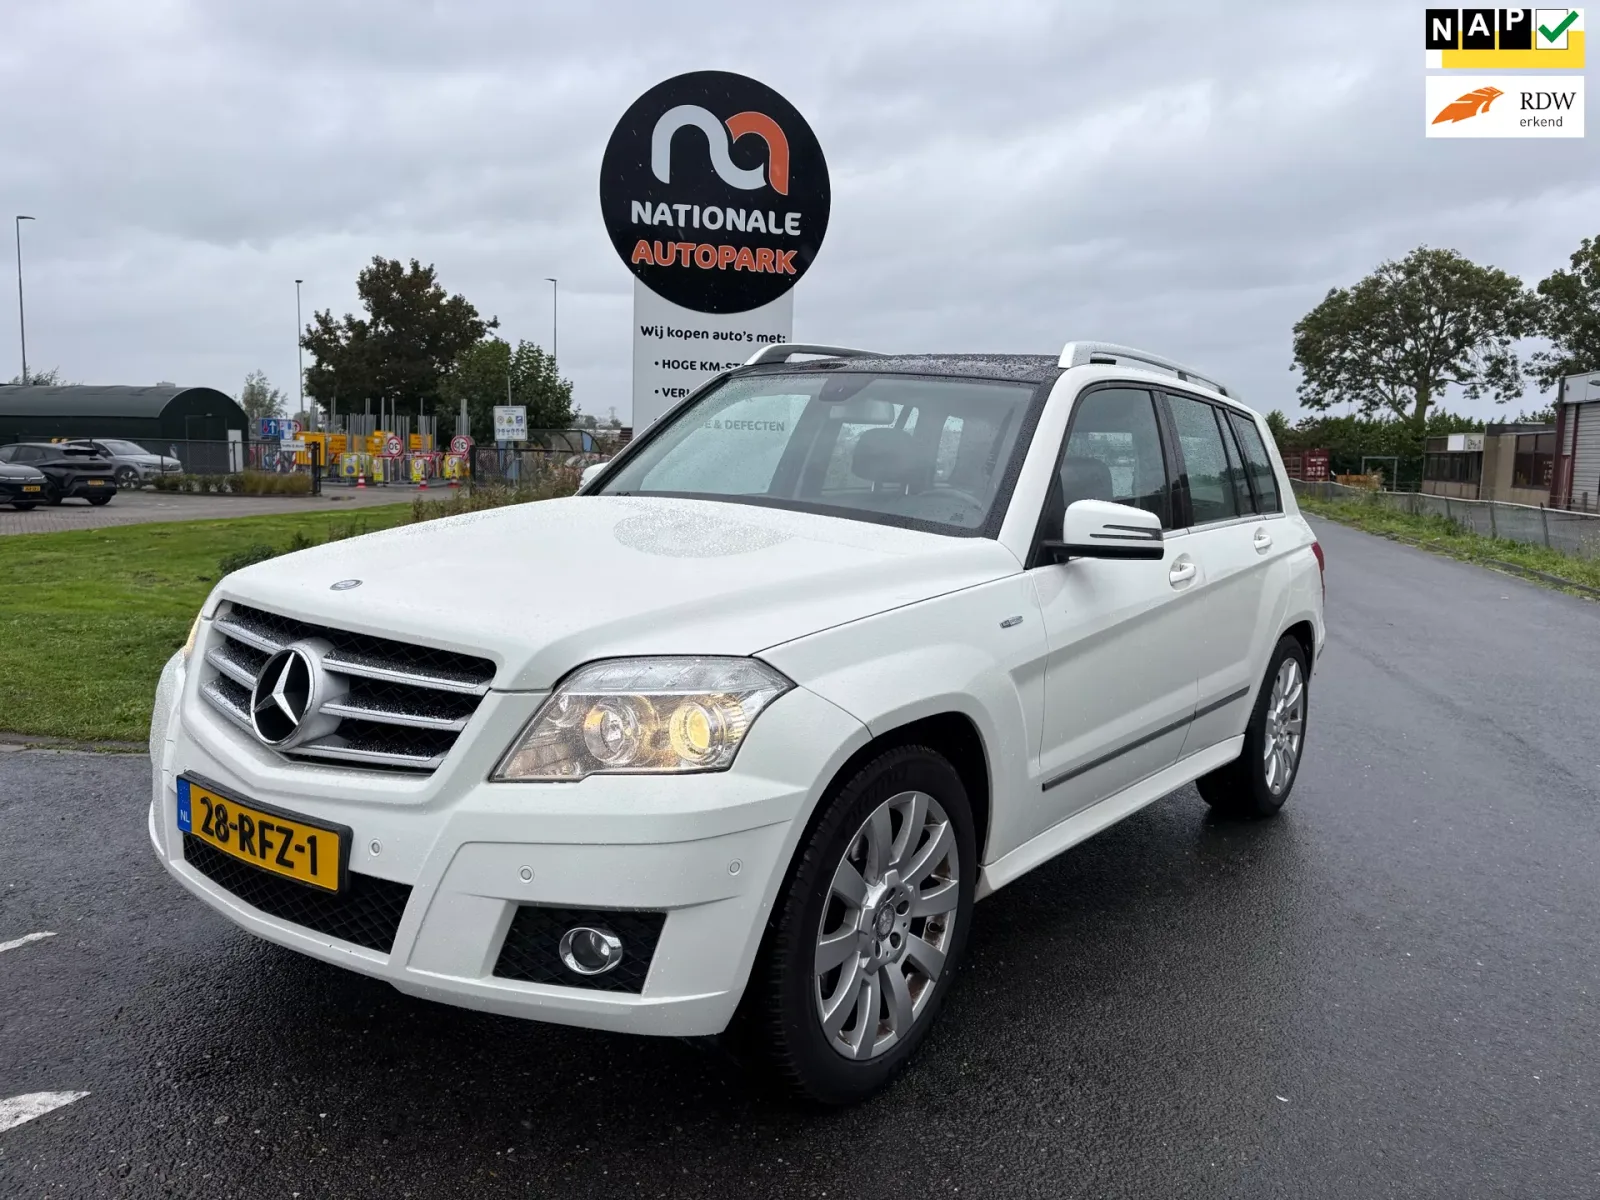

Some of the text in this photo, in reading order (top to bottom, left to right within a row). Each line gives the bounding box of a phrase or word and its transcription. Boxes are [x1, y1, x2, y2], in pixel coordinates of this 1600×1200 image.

[631, 200, 802, 236] NATIONALE
[631, 239, 798, 275] AUTOPARK
[640, 325, 786, 343] Wij kopen auto's met:
[662, 359, 745, 371] HOGE KM-ST
[724, 420, 785, 432] DEFECTEN
[180, 809, 190, 823] NL
[200, 796, 318, 876] 28-RFZ-1
